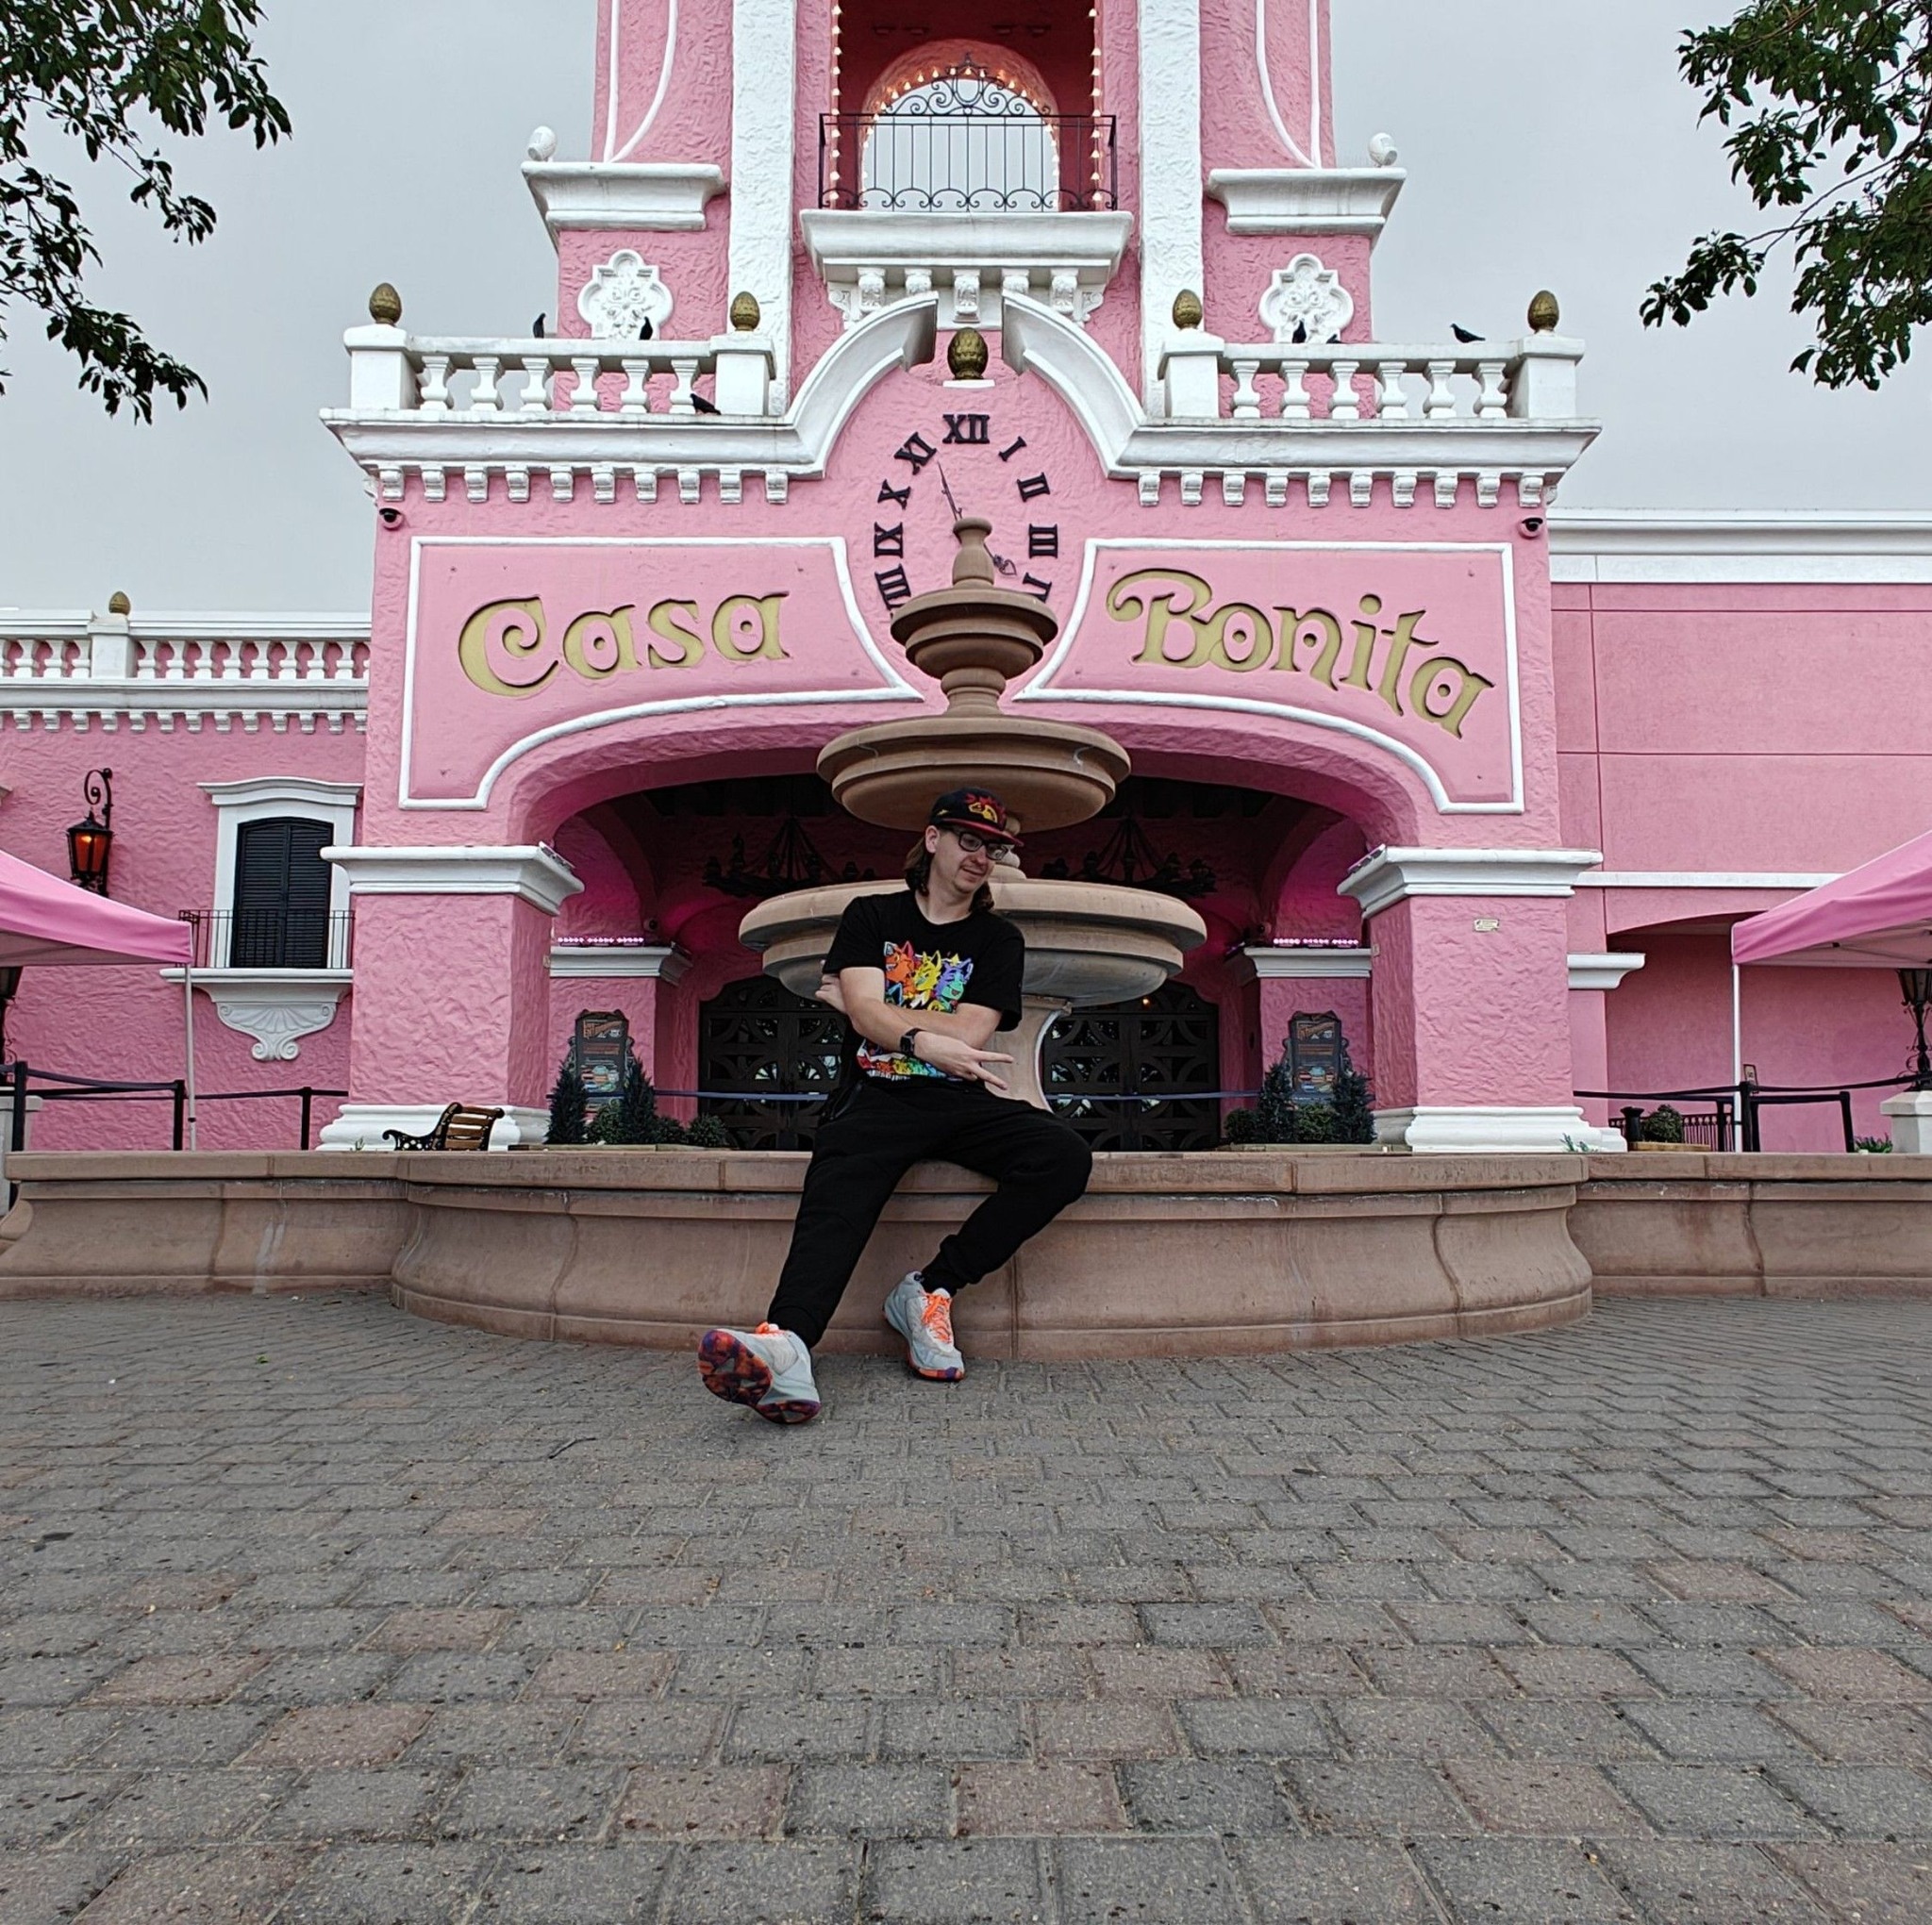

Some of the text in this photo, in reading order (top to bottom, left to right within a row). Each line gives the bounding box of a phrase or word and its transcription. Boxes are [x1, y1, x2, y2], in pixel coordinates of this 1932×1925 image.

[941, 414, 990, 444] XII
[894, 432, 937, 475] XI
[998, 437, 1027, 462] I
[877, 479, 911, 510] X
[1017, 473, 1051, 502] II
[874, 522, 903, 558] IX
[1028, 523, 1058, 558] III
[458, 567, 1496, 740] Casa Bonita
